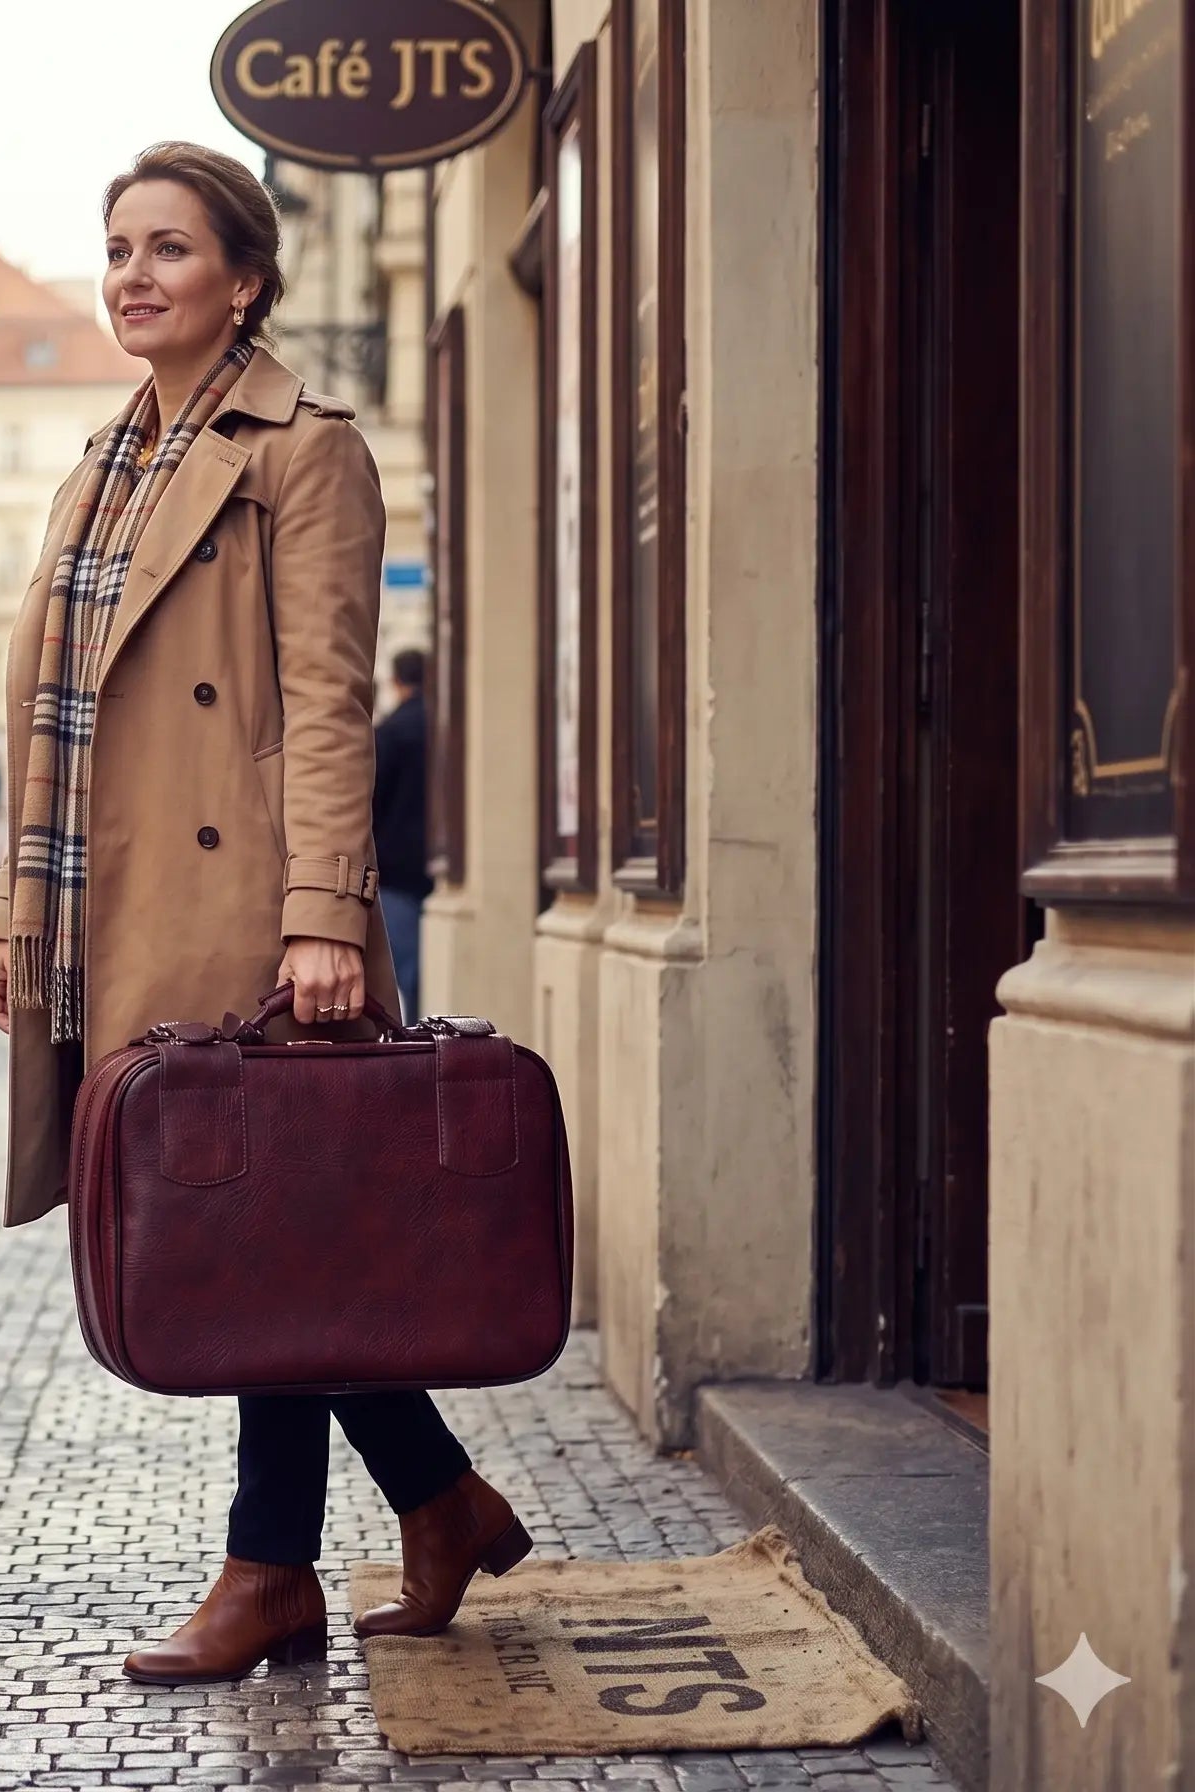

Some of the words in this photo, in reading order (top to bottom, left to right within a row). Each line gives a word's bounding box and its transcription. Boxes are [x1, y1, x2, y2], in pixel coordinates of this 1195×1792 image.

[235, 39, 372, 98] Café
[389, 40, 495, 110] JTS
[558, 1615, 767, 1716] NTS
